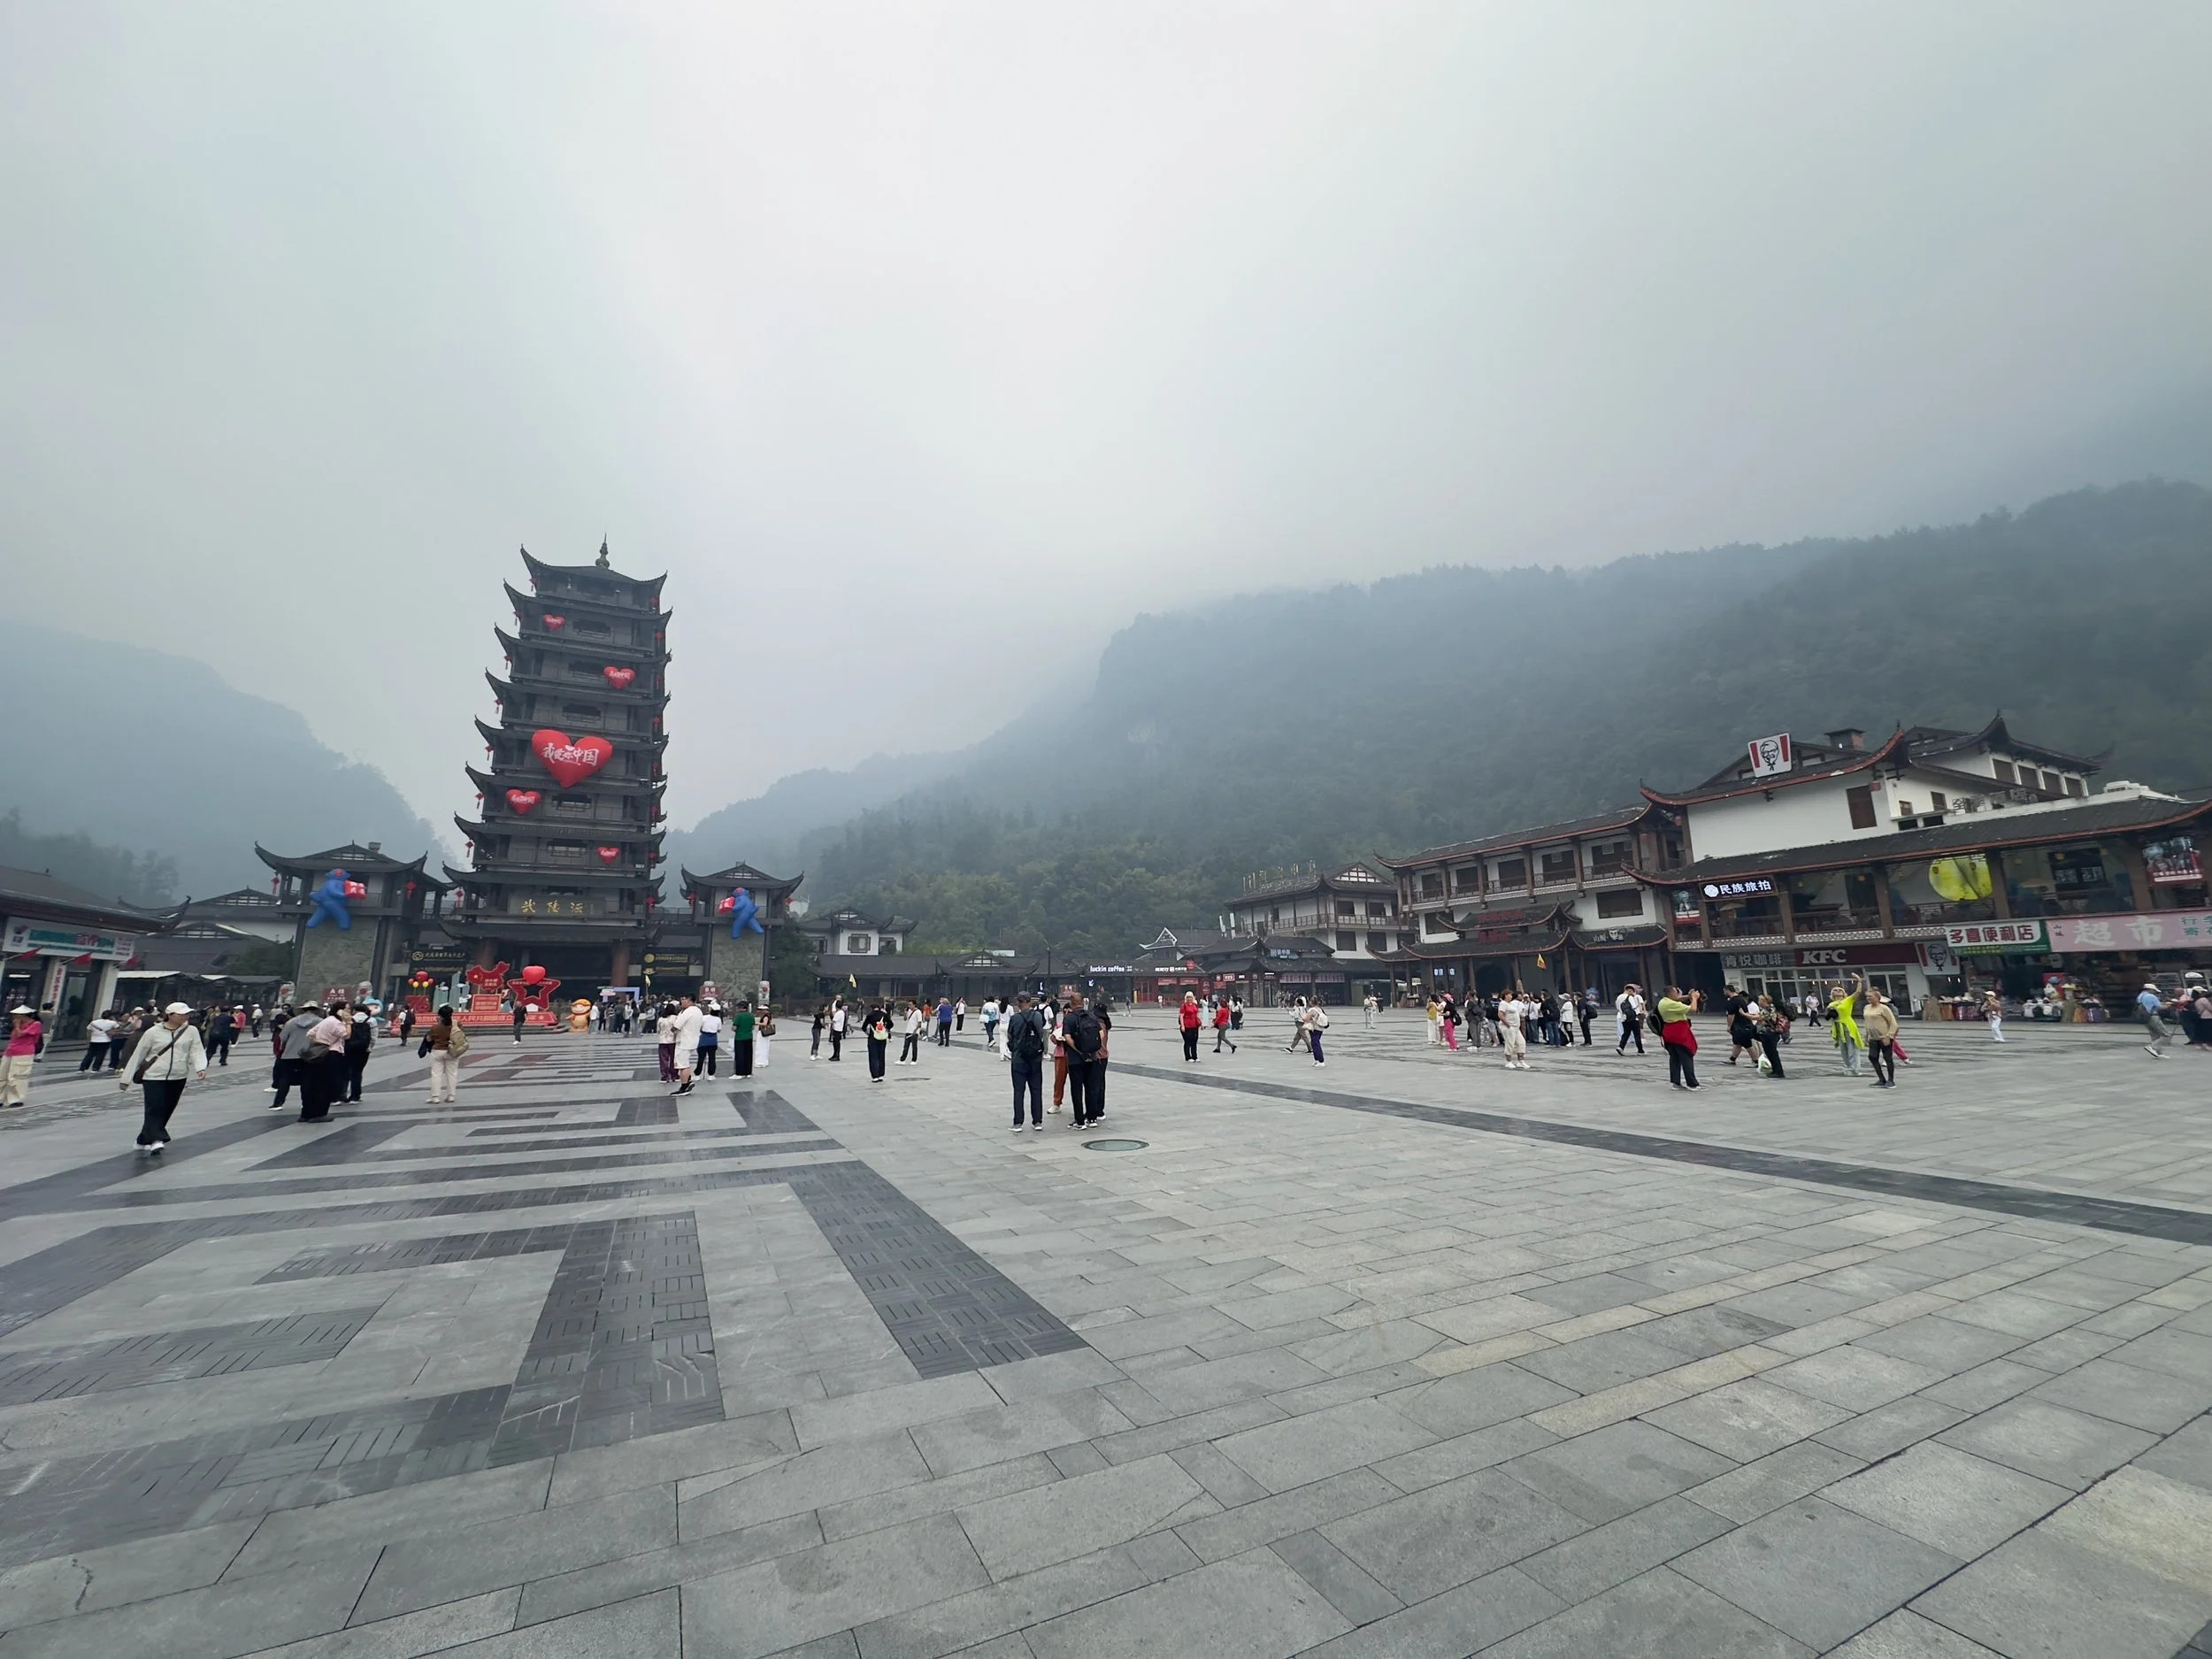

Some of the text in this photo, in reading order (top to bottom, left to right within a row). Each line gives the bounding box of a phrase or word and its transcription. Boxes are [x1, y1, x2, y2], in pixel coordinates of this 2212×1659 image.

[1719, 879, 1772, 895] 民族旅拍
[1950, 925, 2035, 944] 多喜便利店
[2073, 915, 2163, 947] 超市
[1726, 953, 1783, 968] 肯悦咖啡
[1802, 949, 1847, 964] KFC
